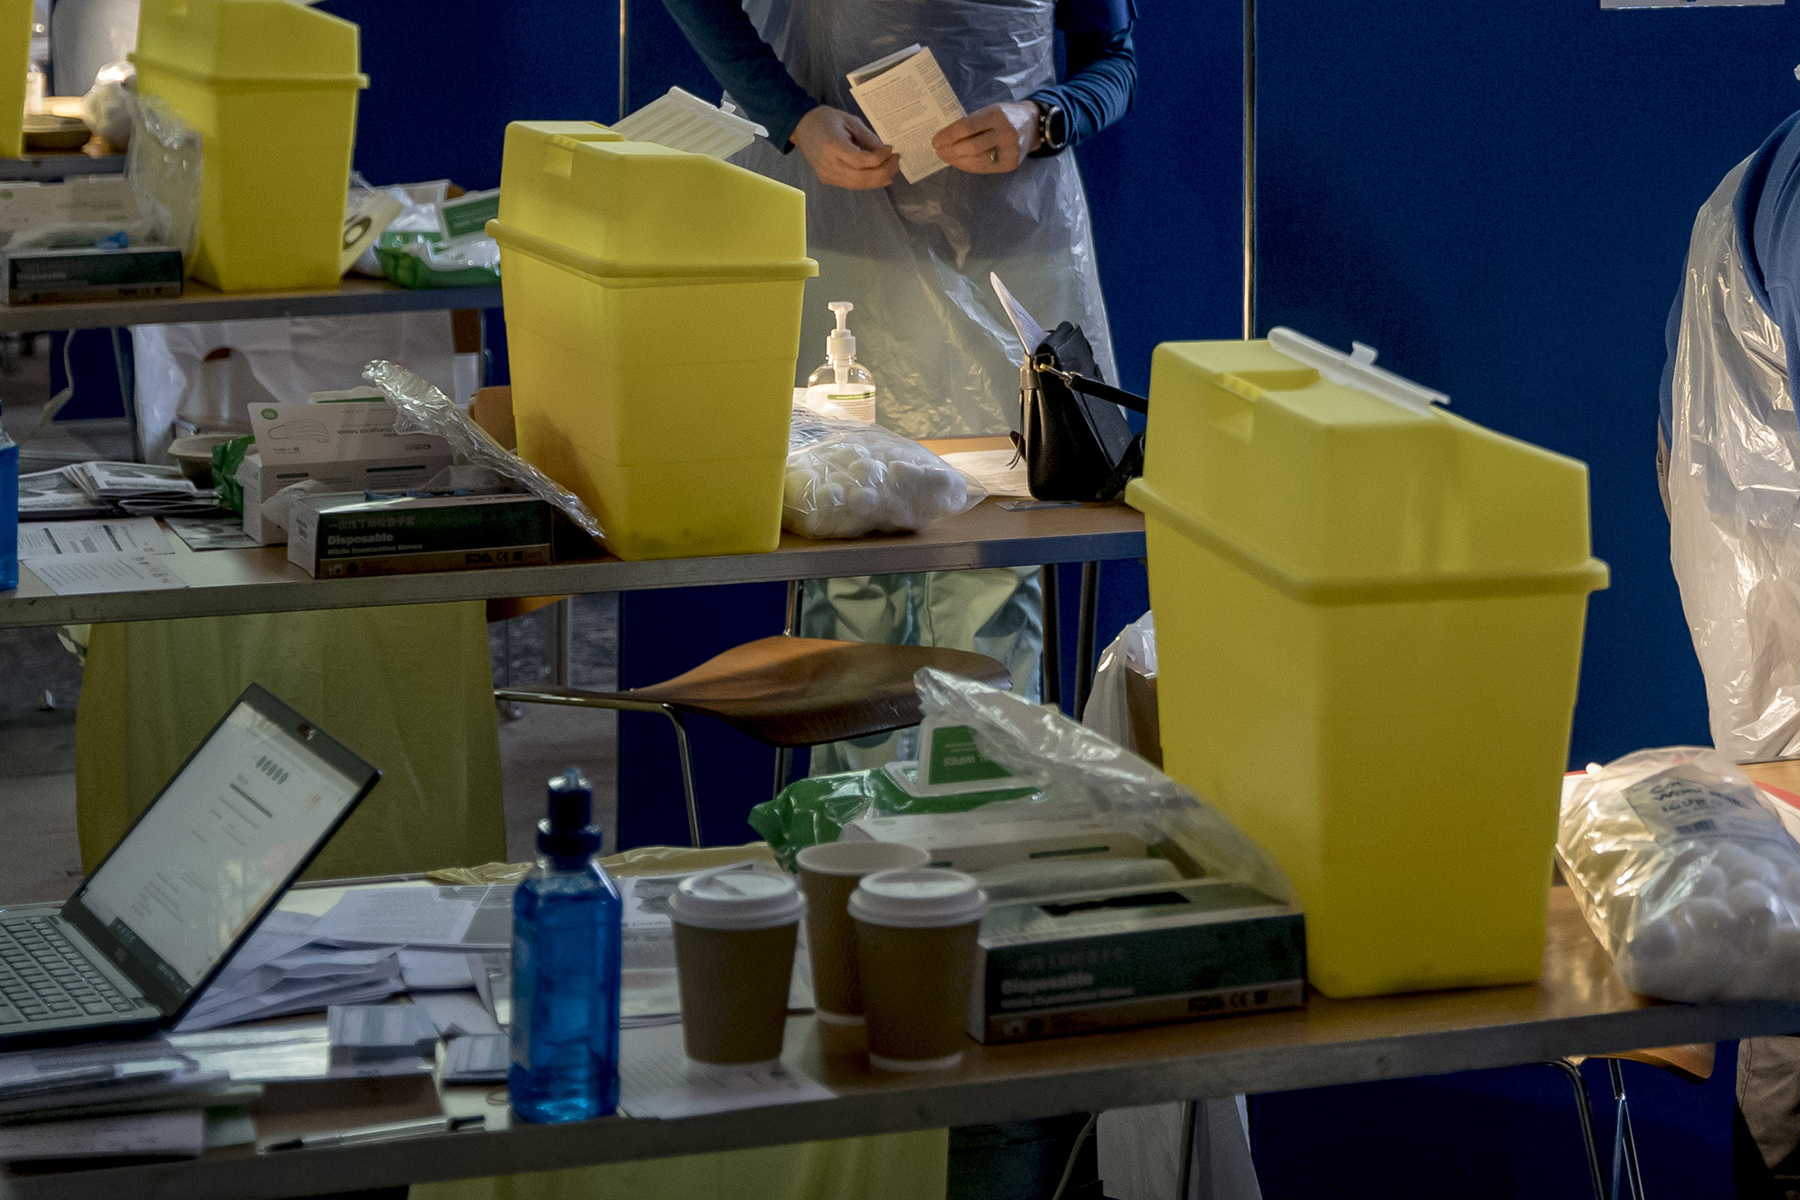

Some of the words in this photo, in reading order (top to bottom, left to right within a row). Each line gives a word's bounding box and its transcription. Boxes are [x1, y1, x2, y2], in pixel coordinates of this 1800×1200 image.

[327, 532, 394, 547] Disposable
[351, 545, 397, 554] Examination
[397, 543, 423, 552] Gloves
[465, 552, 493, 565] FDA
[942, 755, 976, 767] WIPES
